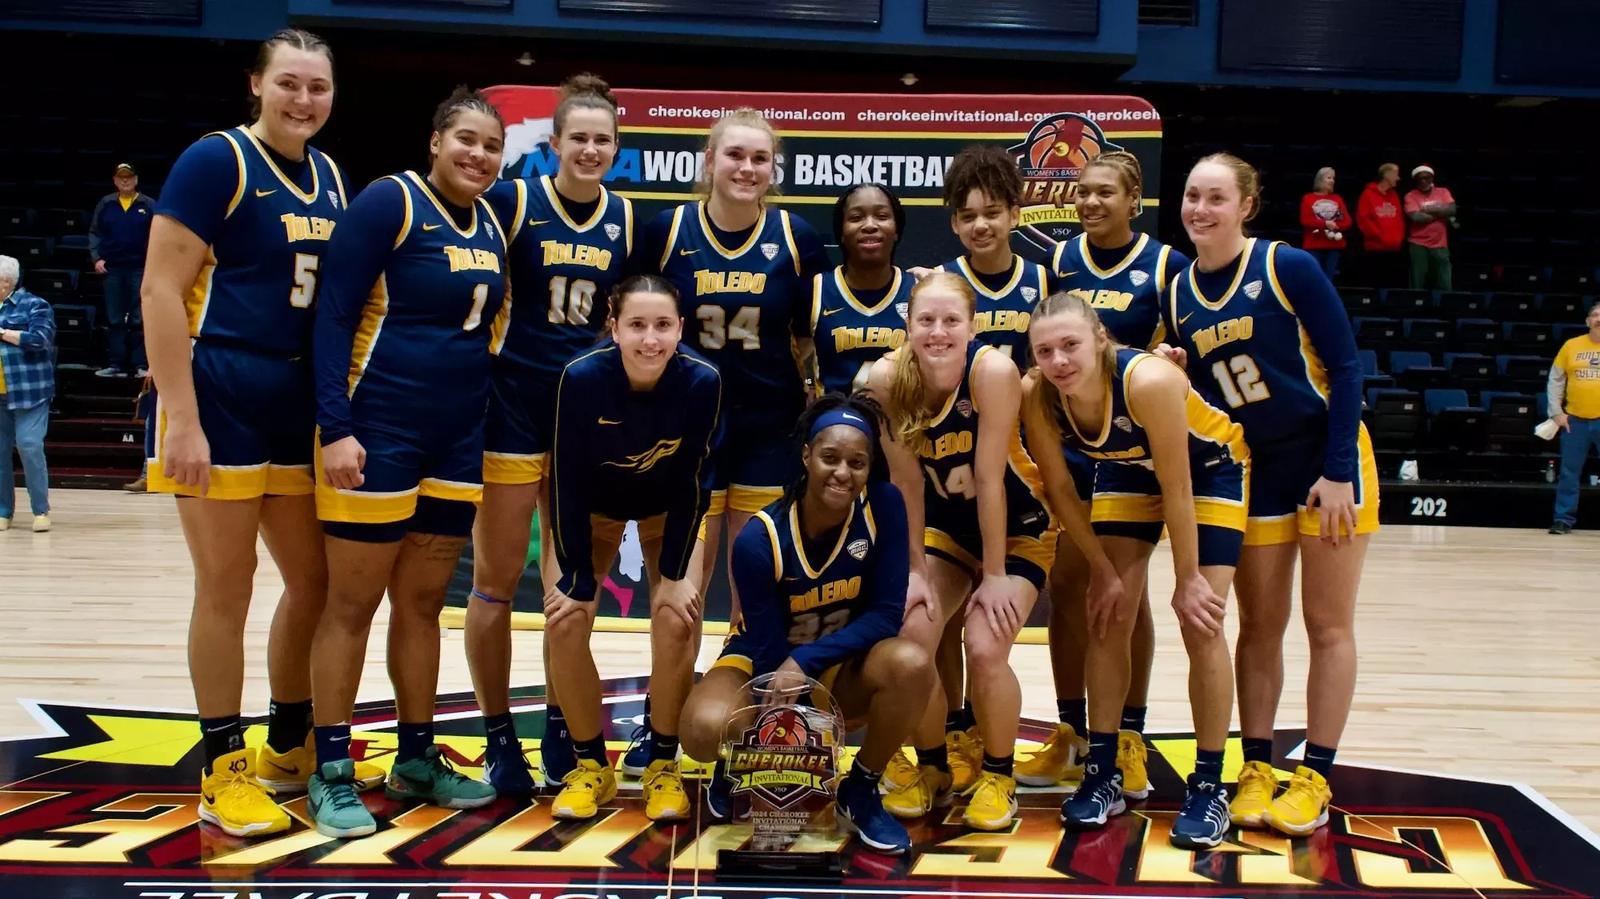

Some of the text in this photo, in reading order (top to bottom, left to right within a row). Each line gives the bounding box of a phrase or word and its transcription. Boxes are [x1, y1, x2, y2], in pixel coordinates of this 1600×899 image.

[648, 106, 845, 120] cherokeeinational.com
[794, 154, 954, 187] BASKETBA
[1023, 208, 1079, 223] INVITATIO
[541, 240, 612, 271] TOLEDO
[290, 252, 318, 308] 5
[694, 269, 767, 297] TOLEDO
[463, 283, 489, 331] 1
[696, 304, 761, 350] 34
[974, 310, 1031, 334] OLEDO
[831, 326, 906, 353] TOLEDO
[1191, 315, 1254, 359] TOLEDO
[1212, 354, 1272, 409] 12
[921, 430, 973, 460] OLEDO
[1411, 497, 1448, 517] 202
[736, 753, 829, 772] CHEROKEE
[754, 773, 809, 784] INVITATIONAL
